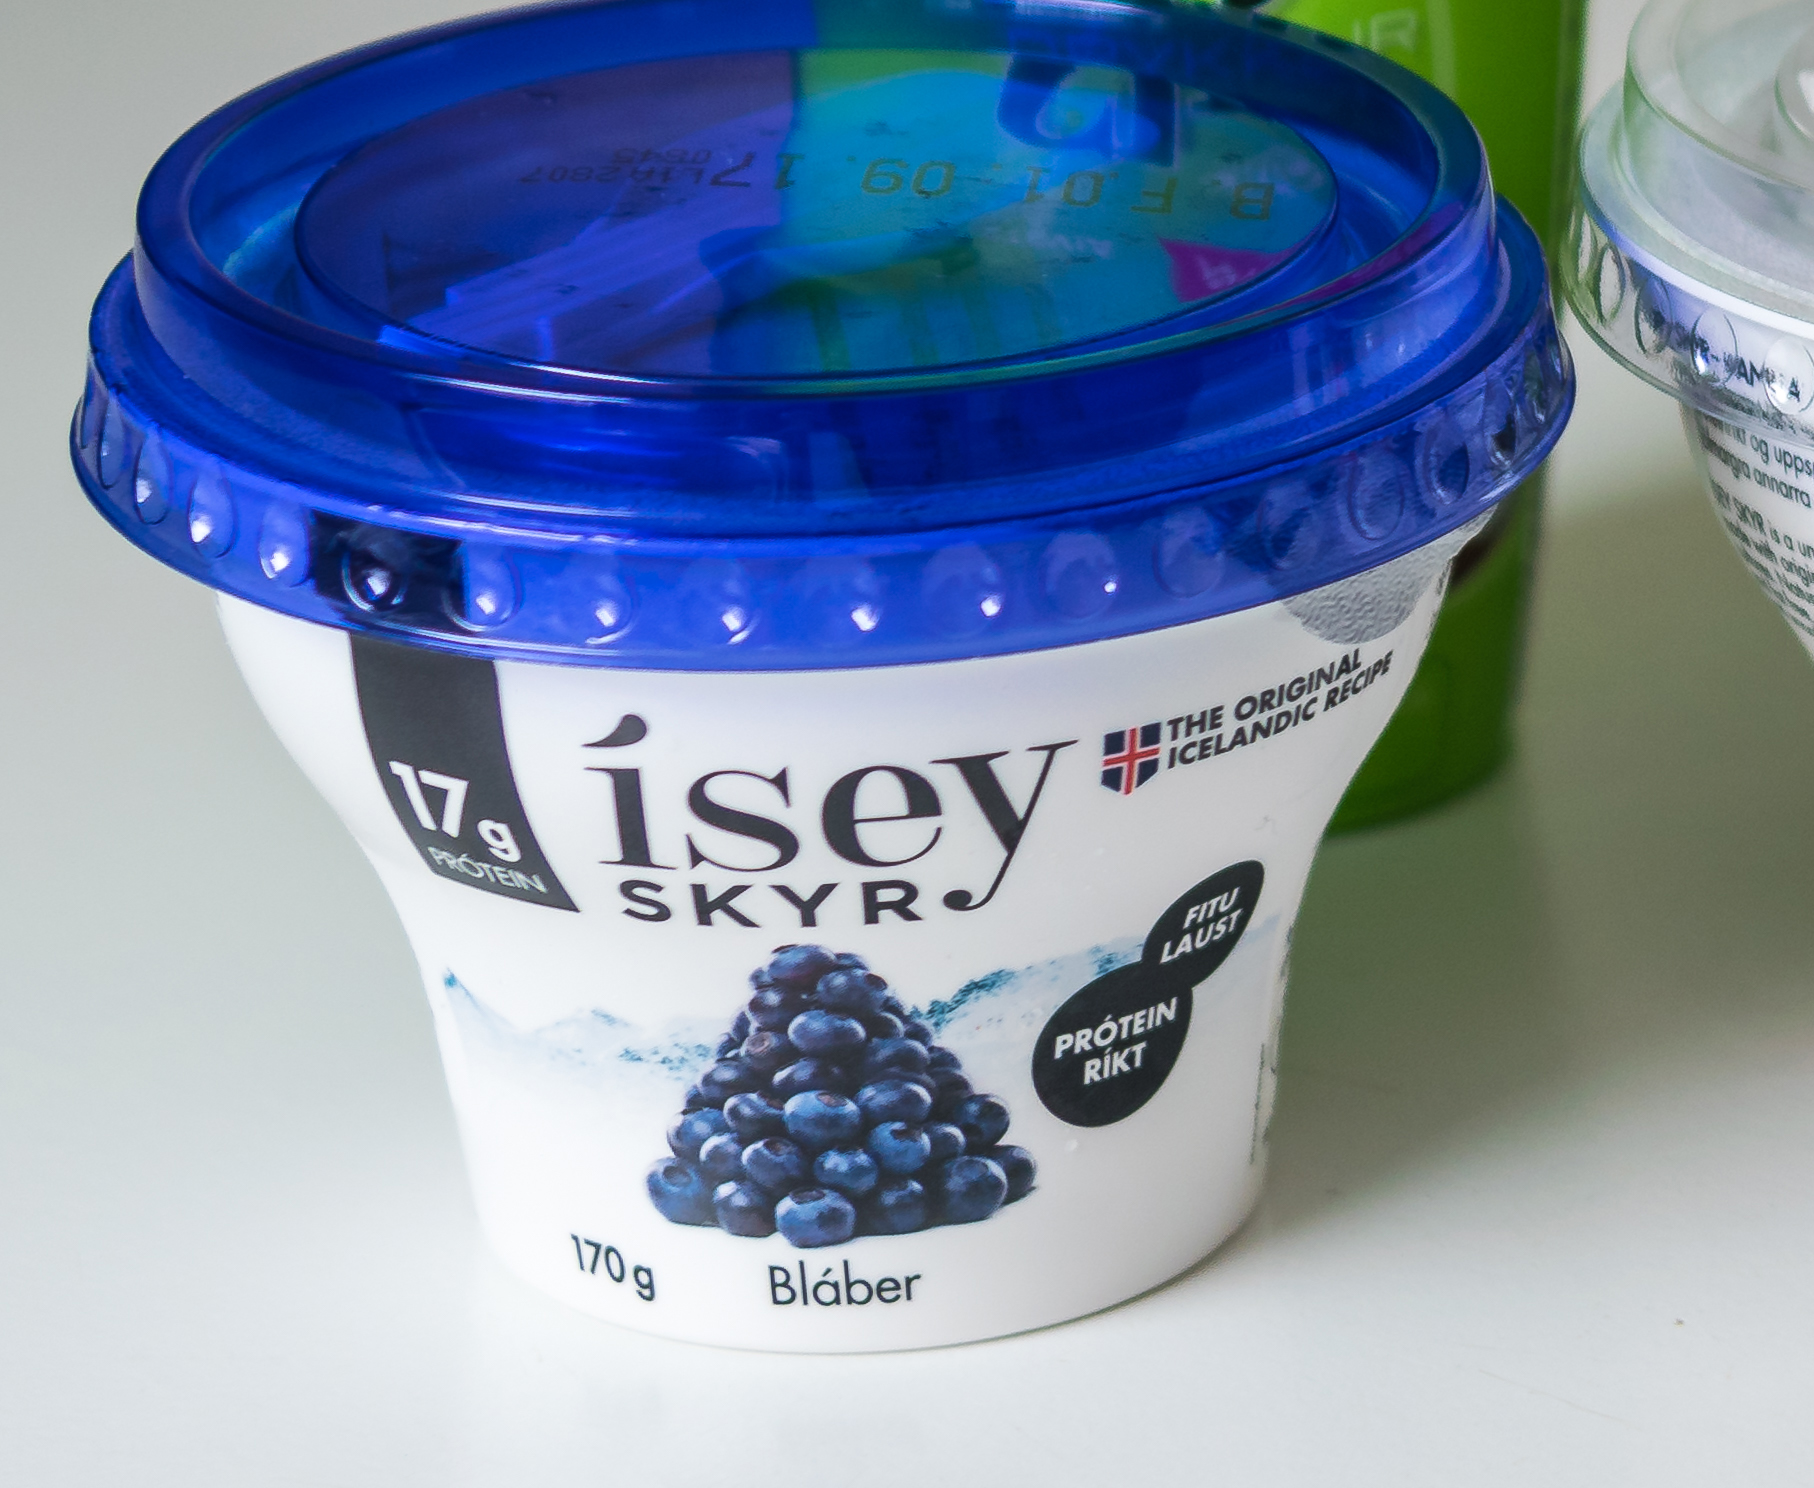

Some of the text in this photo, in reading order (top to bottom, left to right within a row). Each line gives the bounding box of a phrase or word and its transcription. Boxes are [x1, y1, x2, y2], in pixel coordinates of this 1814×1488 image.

[1755, 466, 1811, 509] annarra
[1783, 535, 1795, 552] a
[1167, 647, 1361, 743] THE ORIGINAL
[1167, 648, 1394, 770] ICELANDIC RECIPE
[426, 843, 550, 898] PRÓTEIN
[619, 879, 925, 929] SKYR
[1181, 886, 1241, 930] FITU
[1159, 908, 1244, 964] LAUST
[1053, 996, 1178, 1060] PRÓTEIN
[1082, 1041, 1147, 1086] RÍKT
[768, 1260, 921, 1307] Bláber
